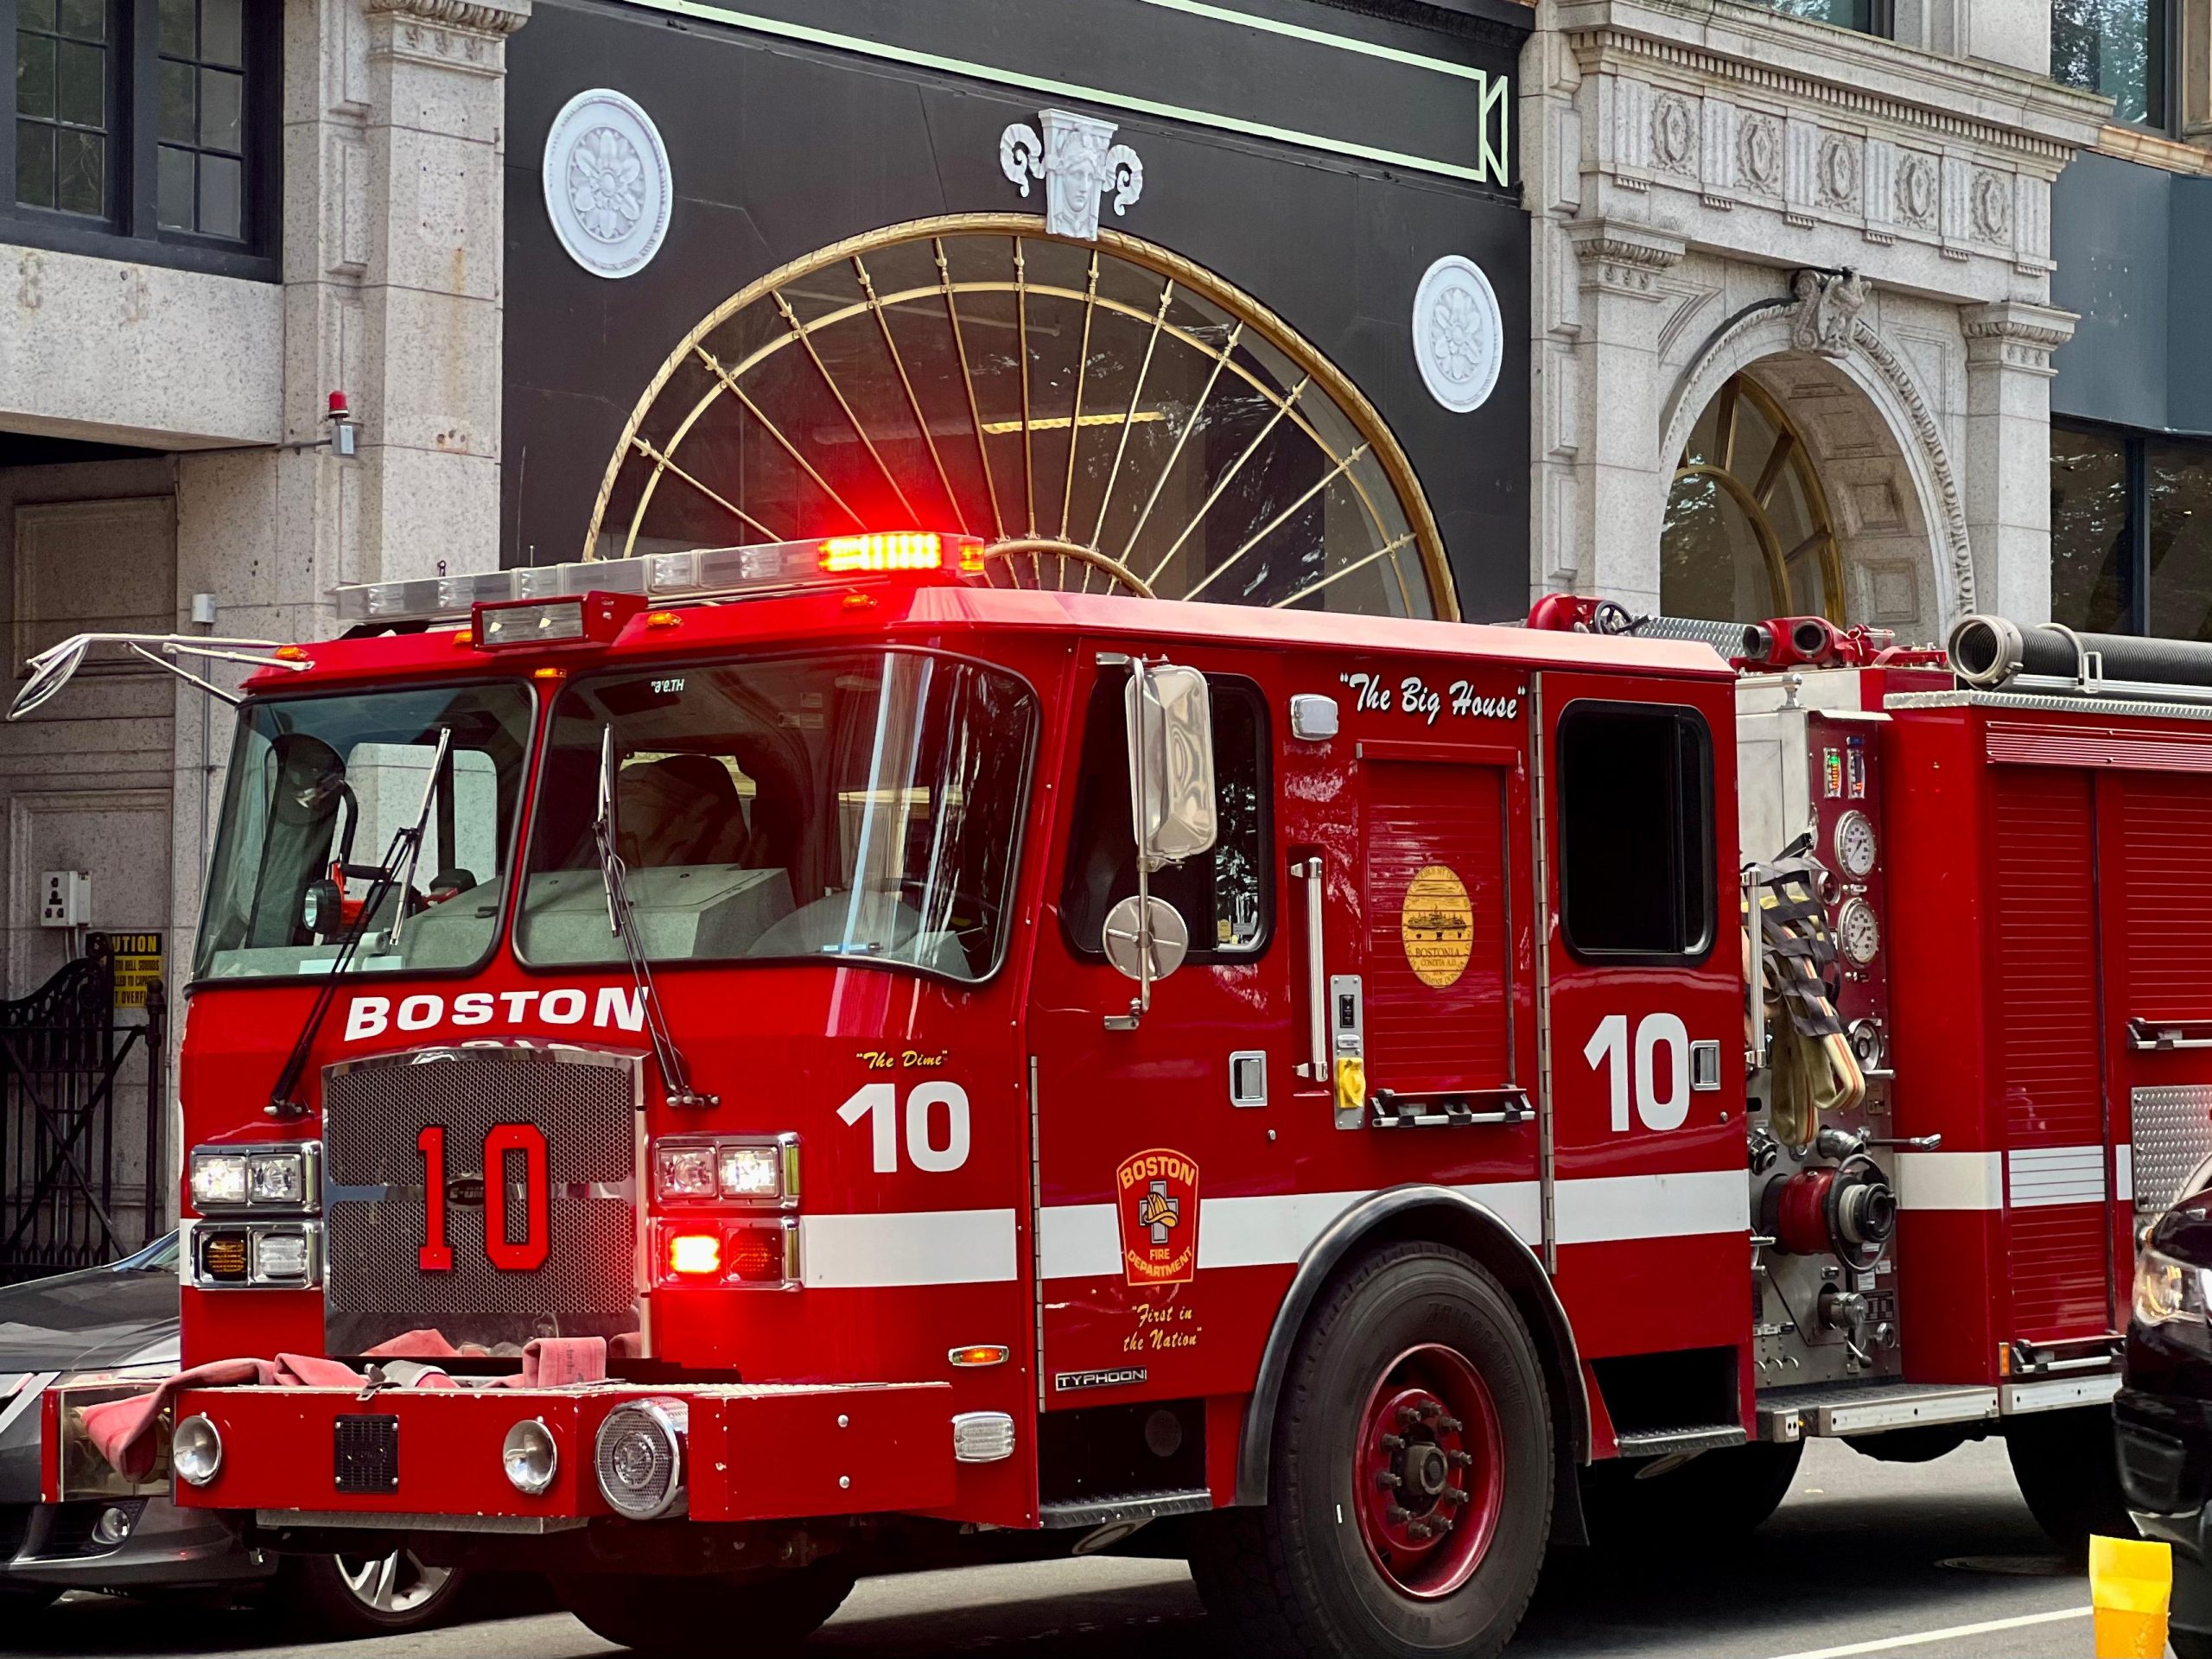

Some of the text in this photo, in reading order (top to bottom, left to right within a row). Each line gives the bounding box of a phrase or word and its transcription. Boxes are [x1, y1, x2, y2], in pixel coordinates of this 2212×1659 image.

[1339, 671, 1526, 725] "The Big House"
[111, 936, 157, 952] UTION
[344, 986, 649, 1042] BOSTON
[855, 1050, 948, 1070] "The Dime"
[1583, 1012, 1690, 1132] 10
[836, 1080, 970, 1173] 10
[1119, 1155, 1196, 1190] BOSTON
[417, 1122, 550, 1271] 10
[1127, 1245, 1192, 1278] DEPARTMENT
[1149, 1248, 1171, 1261] FIRE
[1132, 1303, 1192, 1328] "First in
[1123, 1326, 1203, 1352] the Nation"
[1058, 1369, 1145, 1387] TYPHOON
